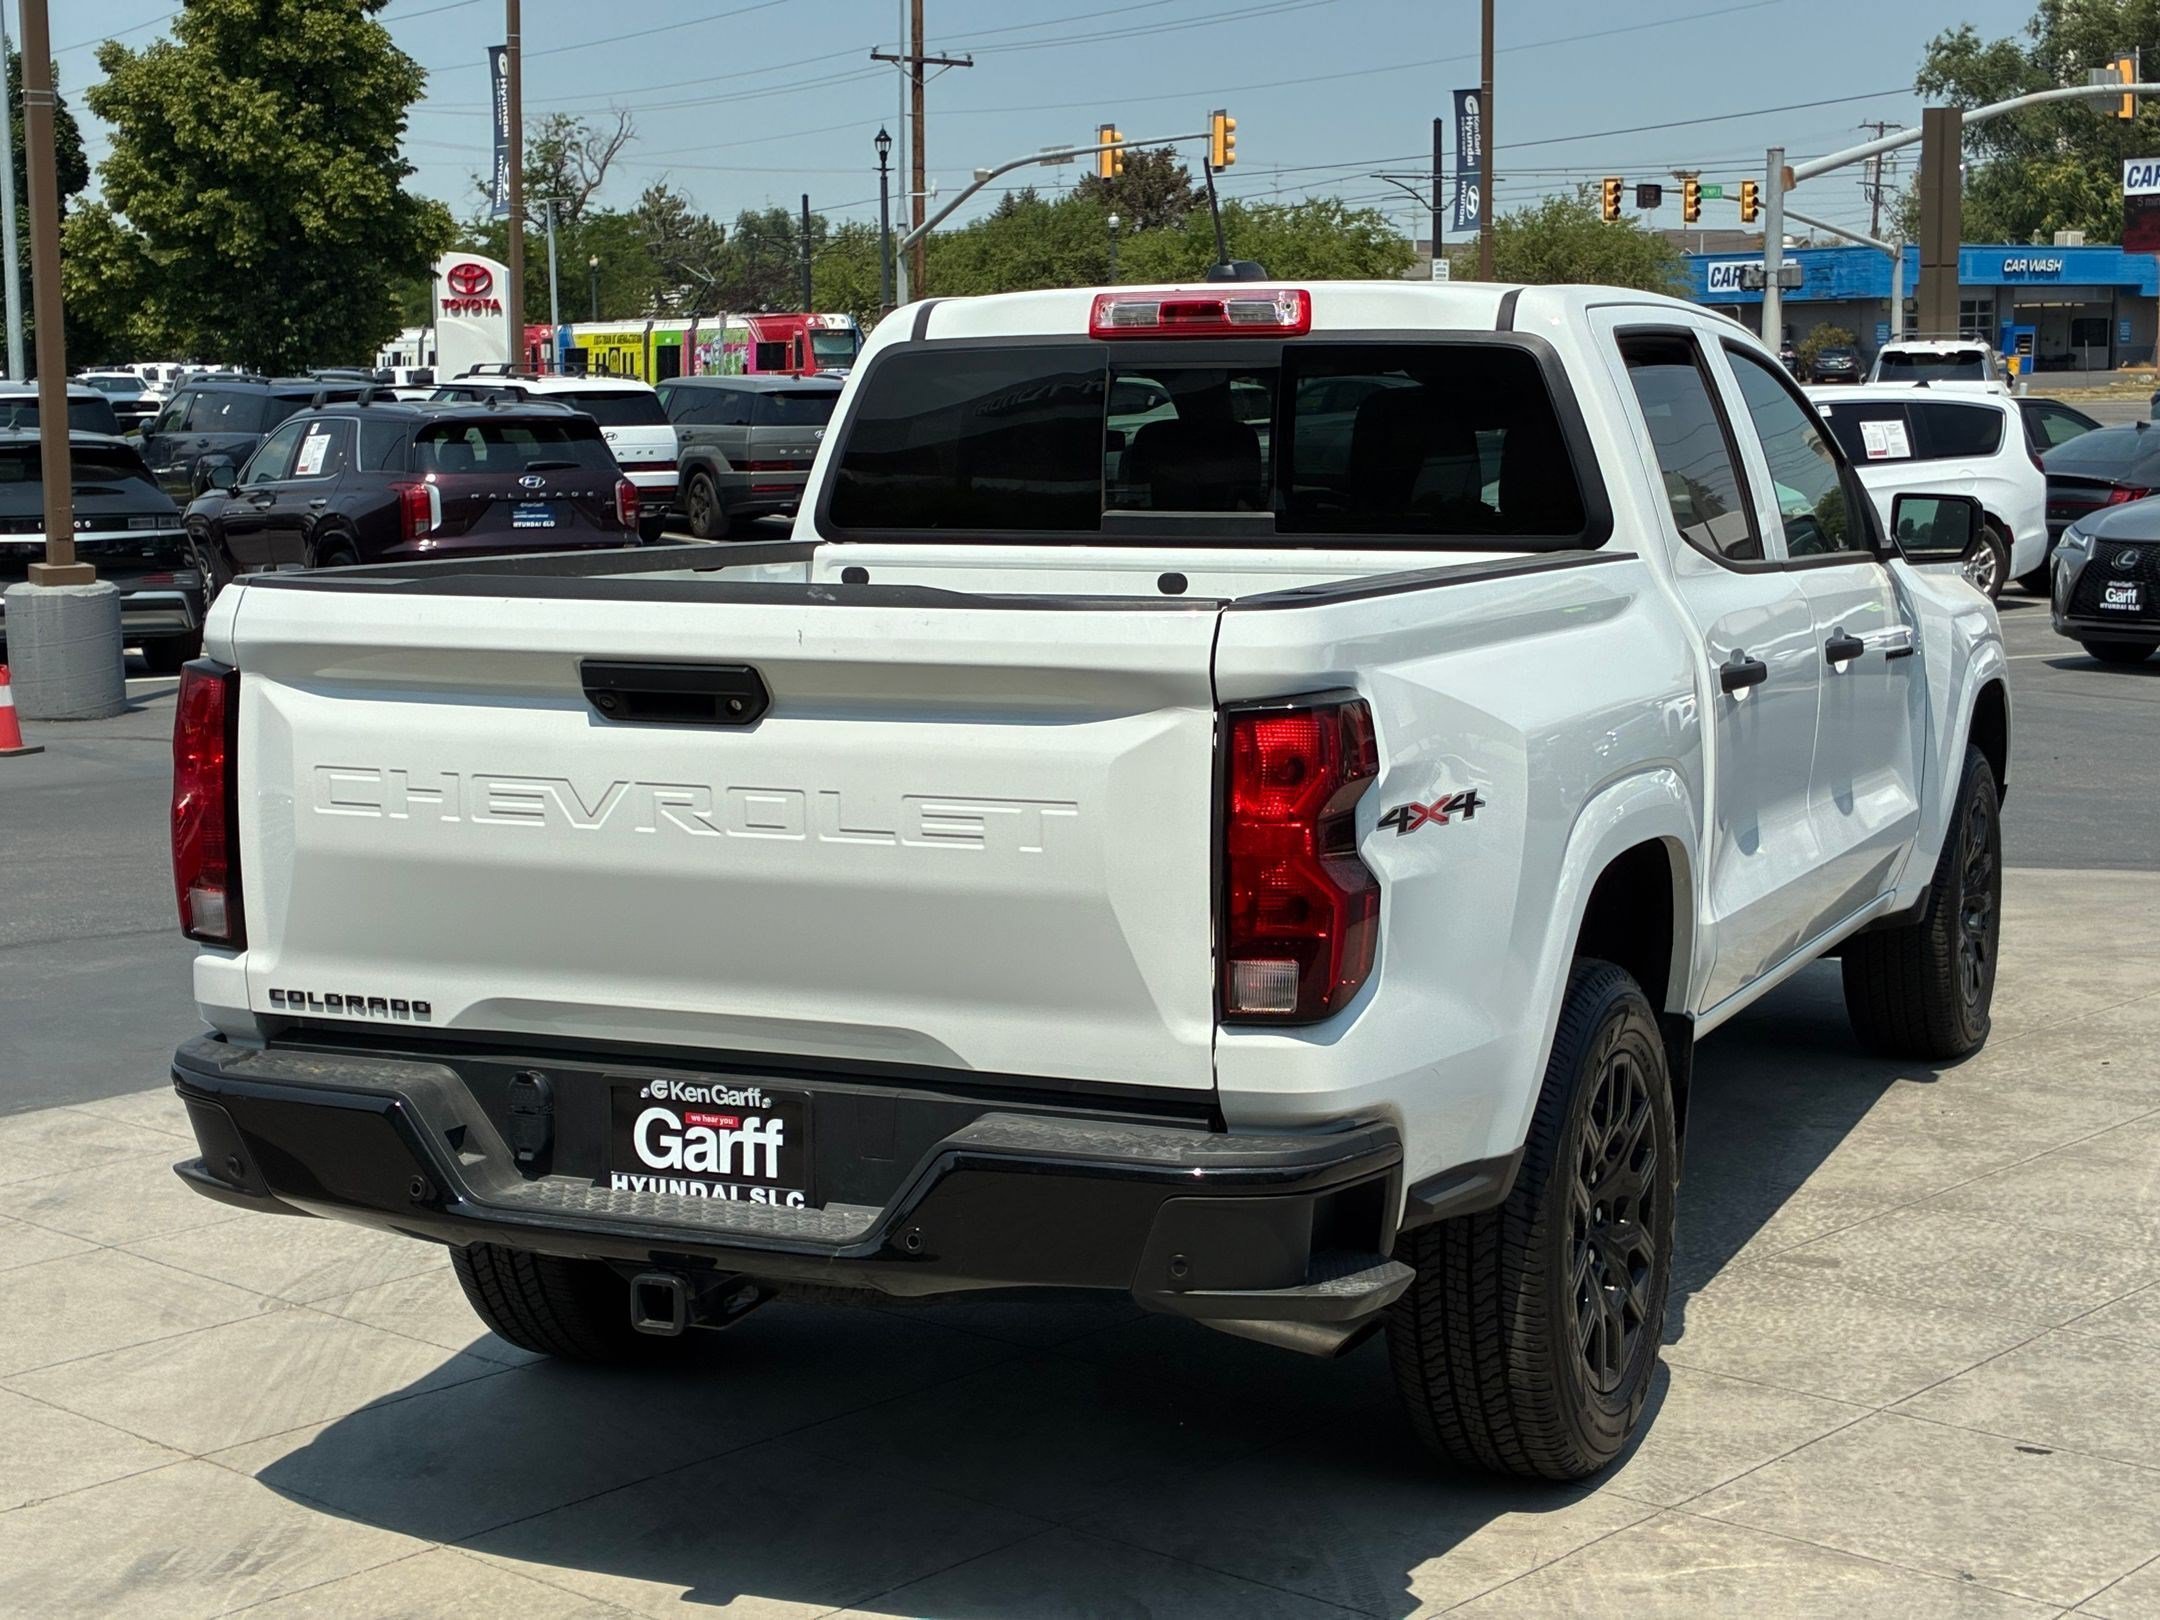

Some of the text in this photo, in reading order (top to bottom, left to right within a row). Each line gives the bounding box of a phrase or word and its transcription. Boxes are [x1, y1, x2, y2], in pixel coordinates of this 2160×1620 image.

[1465, 116, 1475, 167] Hyundai
[496, 155, 504, 208] HYUNDAI
[1458, 181, 1467, 226] HYUNDAI
[2003, 258, 2063, 272] CAR WASH
[440, 298, 502, 312] TOYOTA
[2105, 587, 2137, 604] Garff
[313, 764, 1079, 852] CHEVROLET
[268, 988, 432, 1013] COLORADO
[670, 1080, 761, 1109] Ken Garff
[690, 1114, 734, 1126] we hear you
[633, 1106, 784, 1179] Garff
[610, 1174, 739, 1201] HYUNDAI
